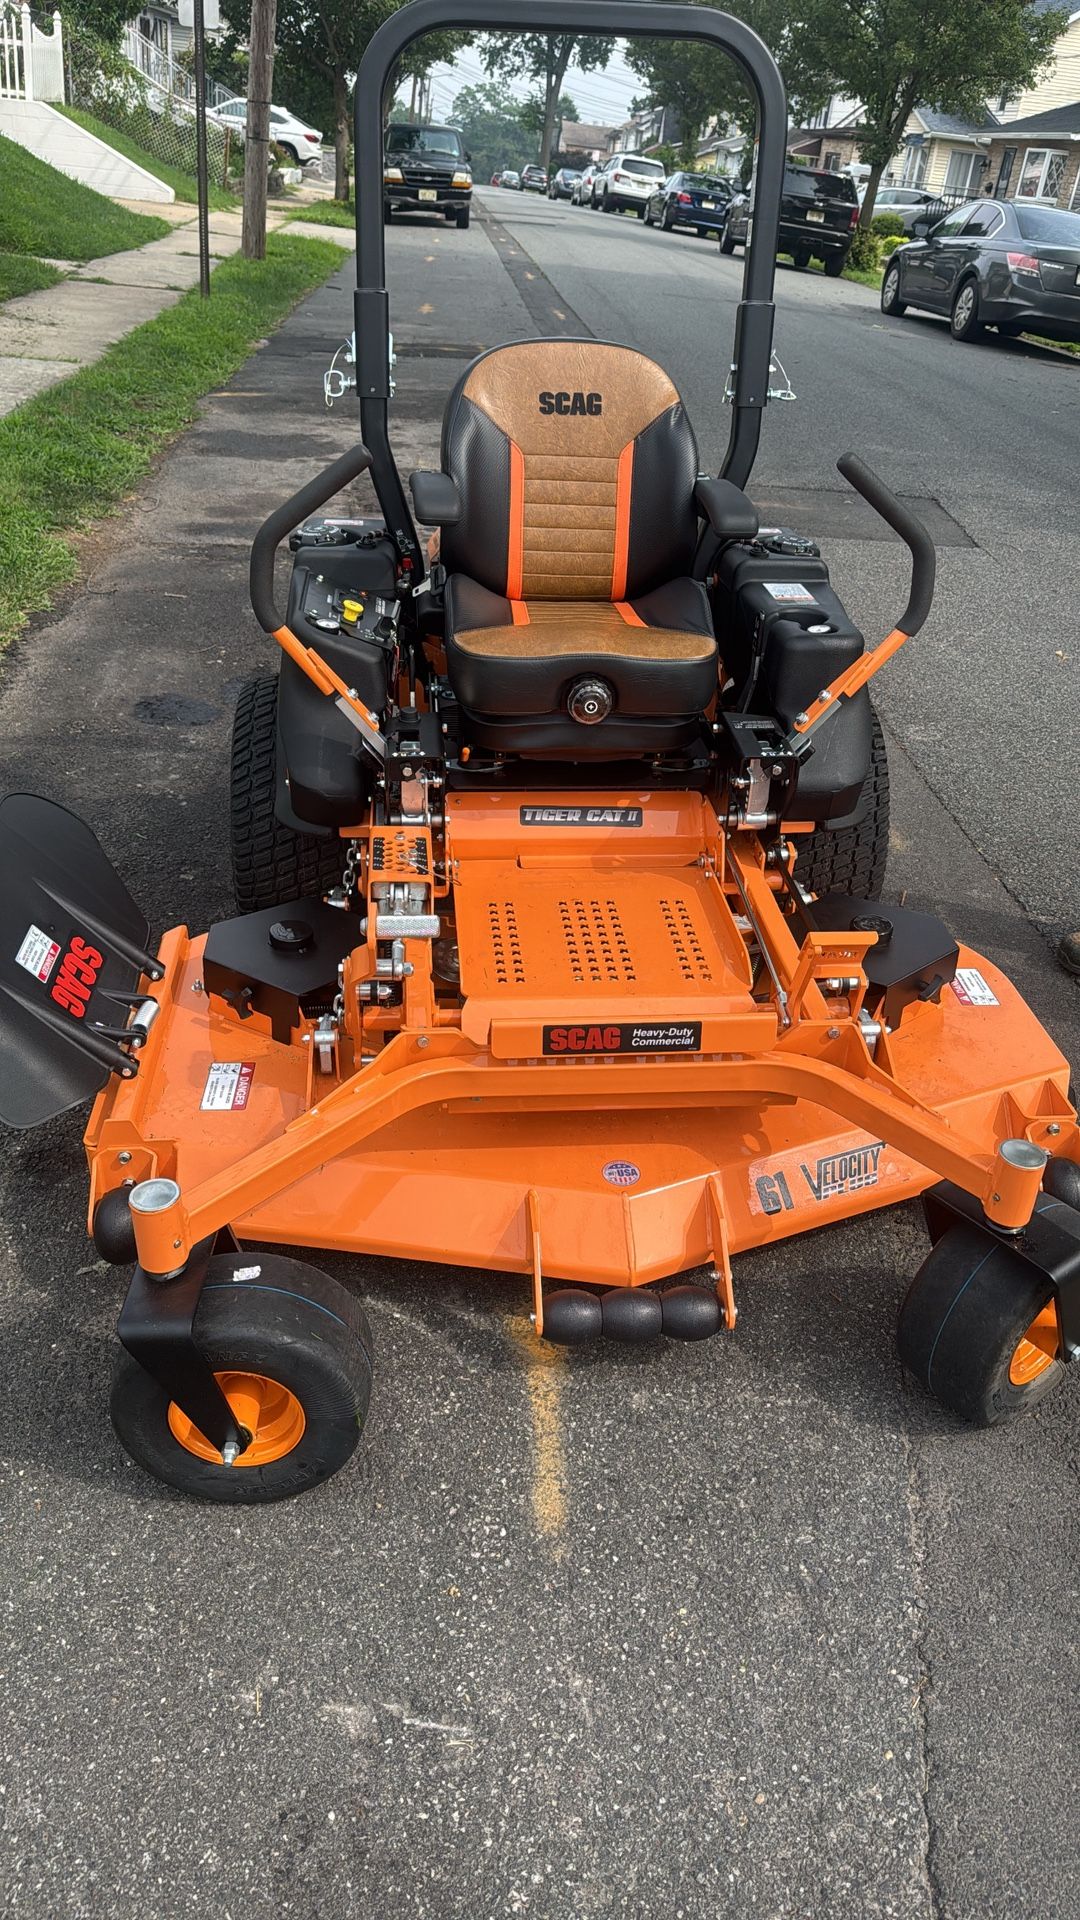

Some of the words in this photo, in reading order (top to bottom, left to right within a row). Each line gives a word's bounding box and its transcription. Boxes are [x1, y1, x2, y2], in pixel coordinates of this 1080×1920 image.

[539, 391, 602, 416] SCAG
[523, 808, 582, 821] TIGER
[627, 810, 639, 821] II
[51, 936, 103, 1018] SCAG
[549, 1026, 621, 1051] SCAG
[631, 1036, 695, 1047] Commercial
[632, 1027, 693, 1038] Heavy-Duty
[234, 1076, 250, 1105] DANGER
[616, 1168, 638, 1177] USA
[755, 1170, 795, 1216] 61
[799, 1140, 885, 1201] VELOCITY
[822, 1172, 879, 1200] PLUS
